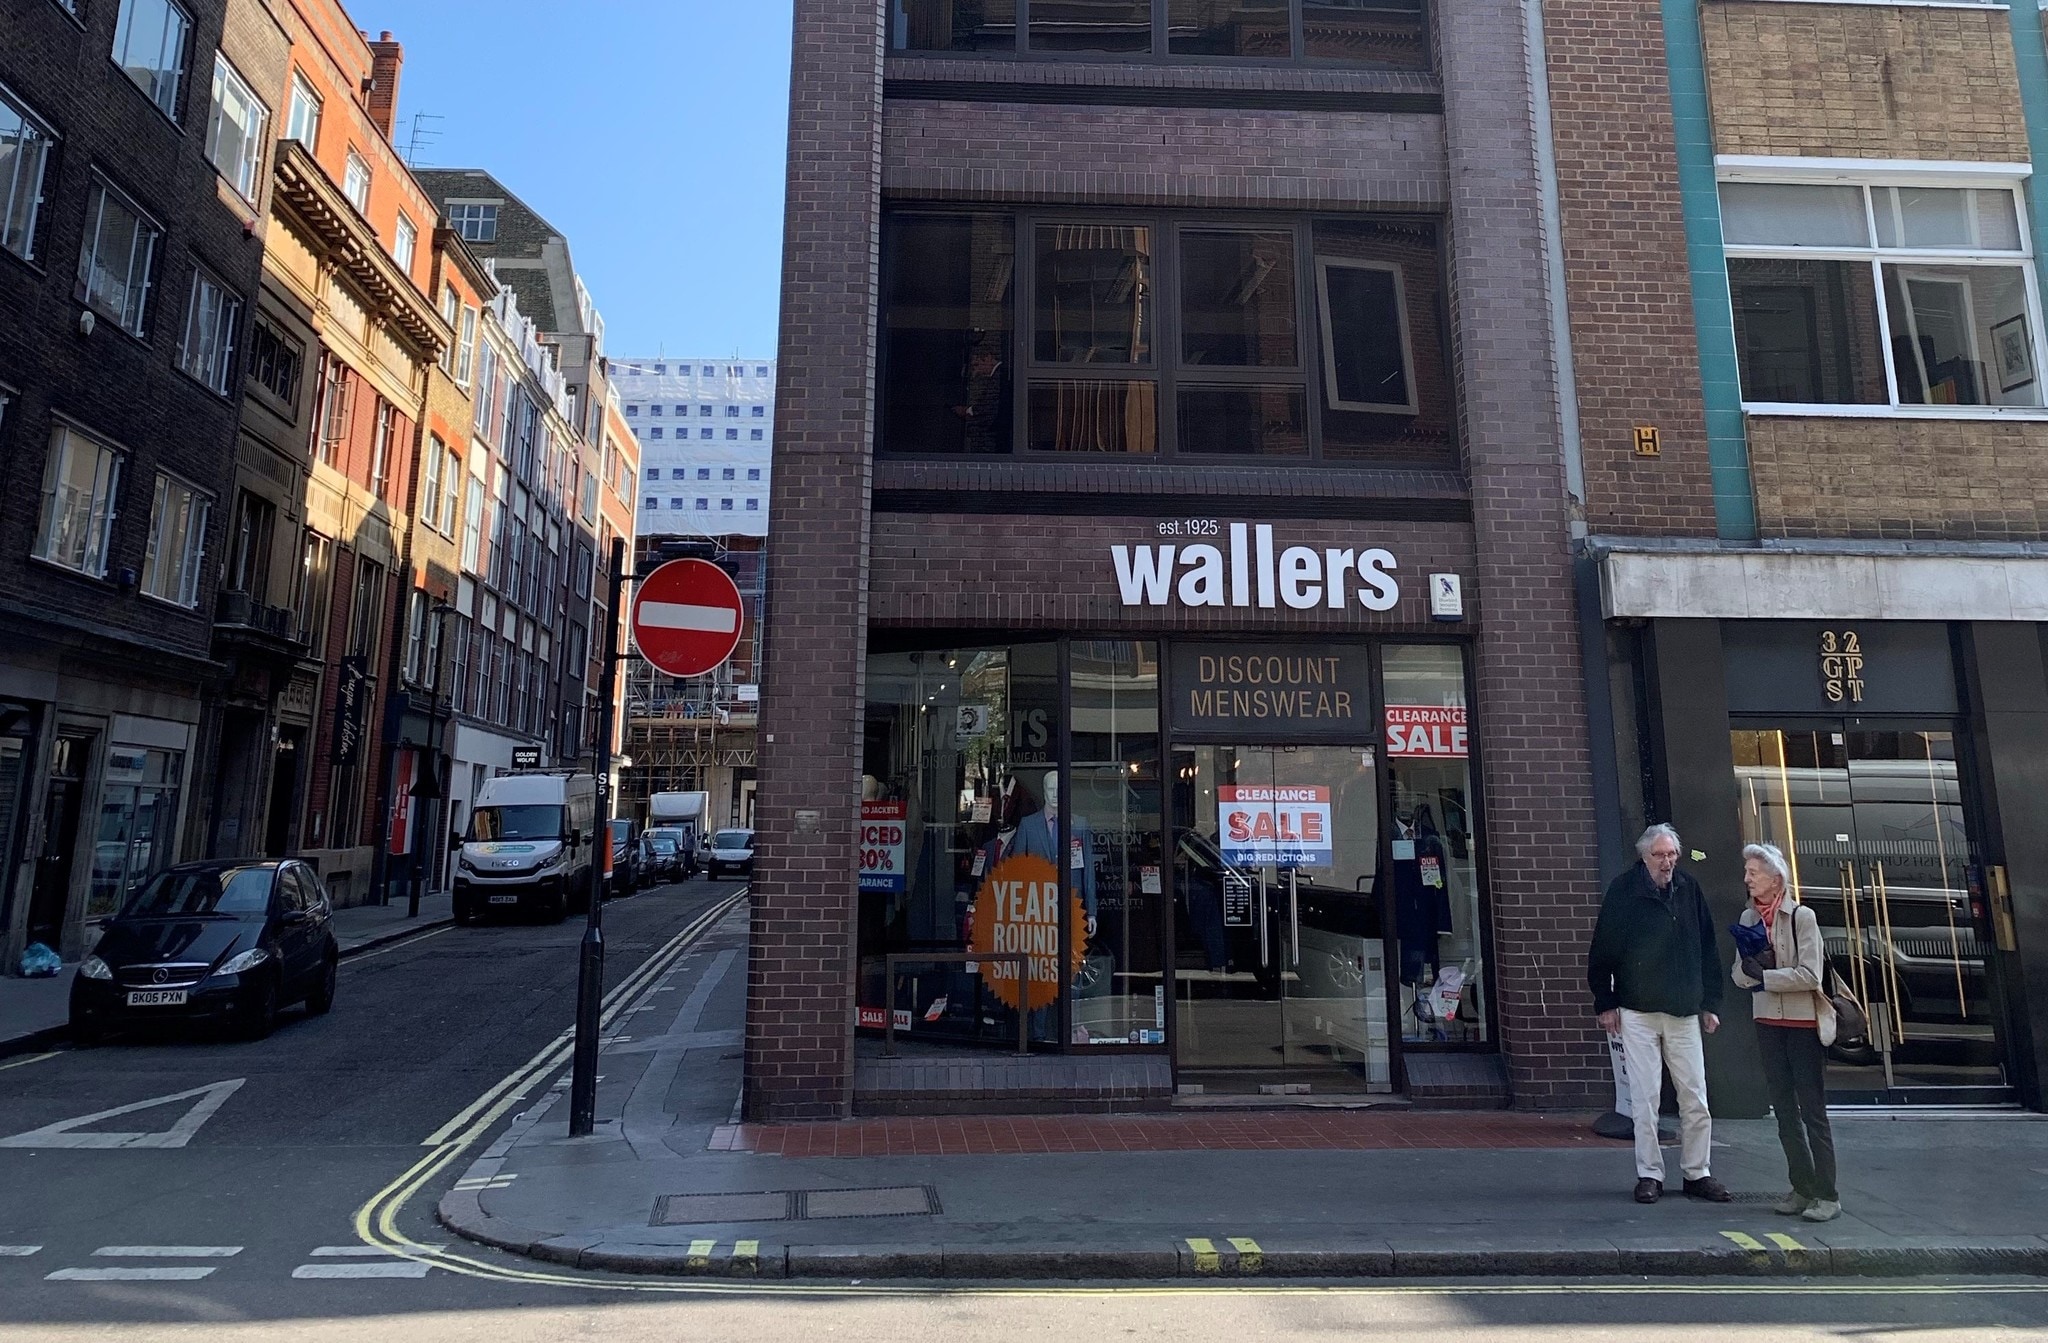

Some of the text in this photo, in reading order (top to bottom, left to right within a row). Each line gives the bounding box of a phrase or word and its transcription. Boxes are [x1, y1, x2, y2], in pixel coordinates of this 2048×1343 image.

[1111, 522, 1400, 611] wallers
[1199, 656, 1340, 684] DISCOUNT
[1826, 680, 1864, 701] ST
[1191, 689, 1352, 717] MENSWEAR
[1386, 709, 1467, 723] CLEARANCE
[1387, 725, 1468, 752] SALE
[598, 773, 607, 784] S
[599, 786, 605, 795] 5
[1235, 789, 1316, 800] CLEARANCE
[871, 806, 898, 814] JACKETS
[1228, 811, 1323, 842] SALE
[1237, 853, 1316, 862] BIG REDUCTIONS
[992, 880, 1058, 923] YEAR
[993, 922, 1058, 955] ROUND
[992, 957, 1058, 982] SAVNGS
[132, 992, 182, 1003] BK06 PXN
[862, 1012, 883, 1023] SALE
